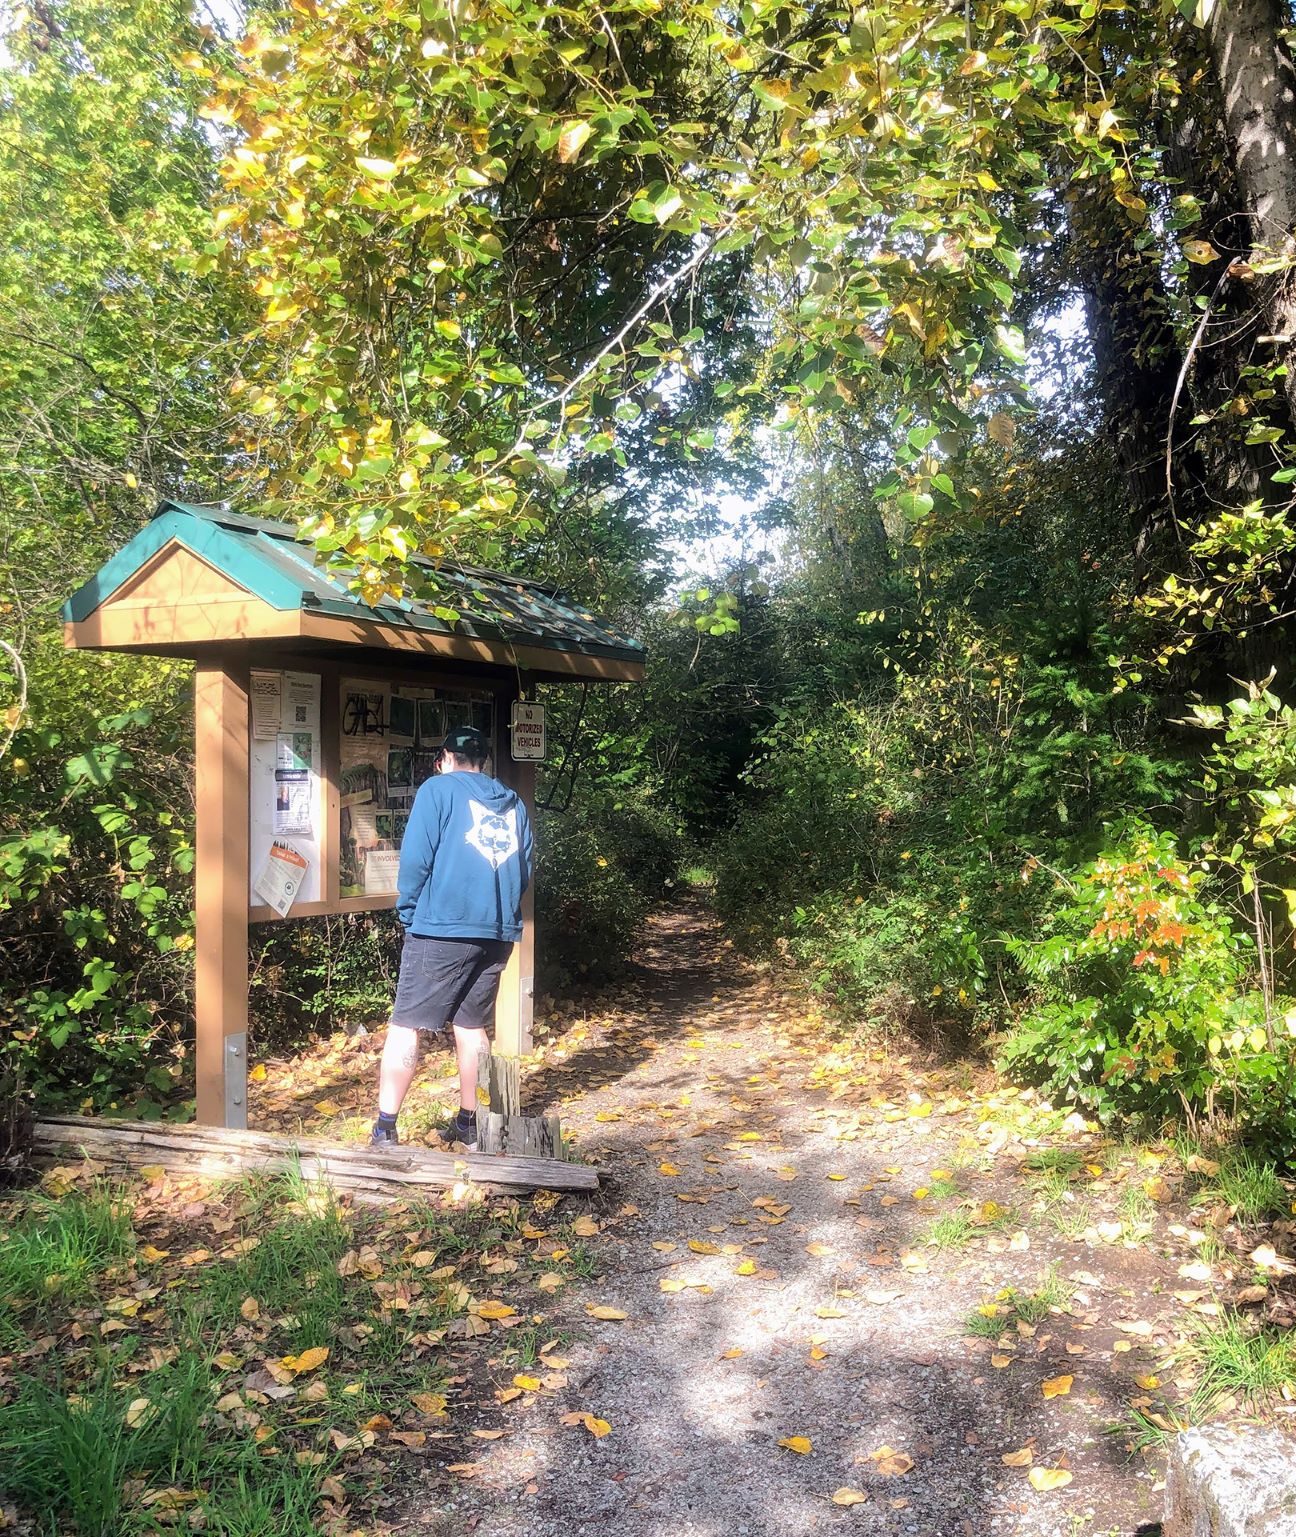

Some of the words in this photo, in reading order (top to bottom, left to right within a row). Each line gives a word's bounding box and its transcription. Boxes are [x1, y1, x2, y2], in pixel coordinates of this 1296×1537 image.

[525, 709, 533, 720] NO
[515, 722, 543, 734] MOTORIZED
[517, 736, 541, 748] VEHICLES
